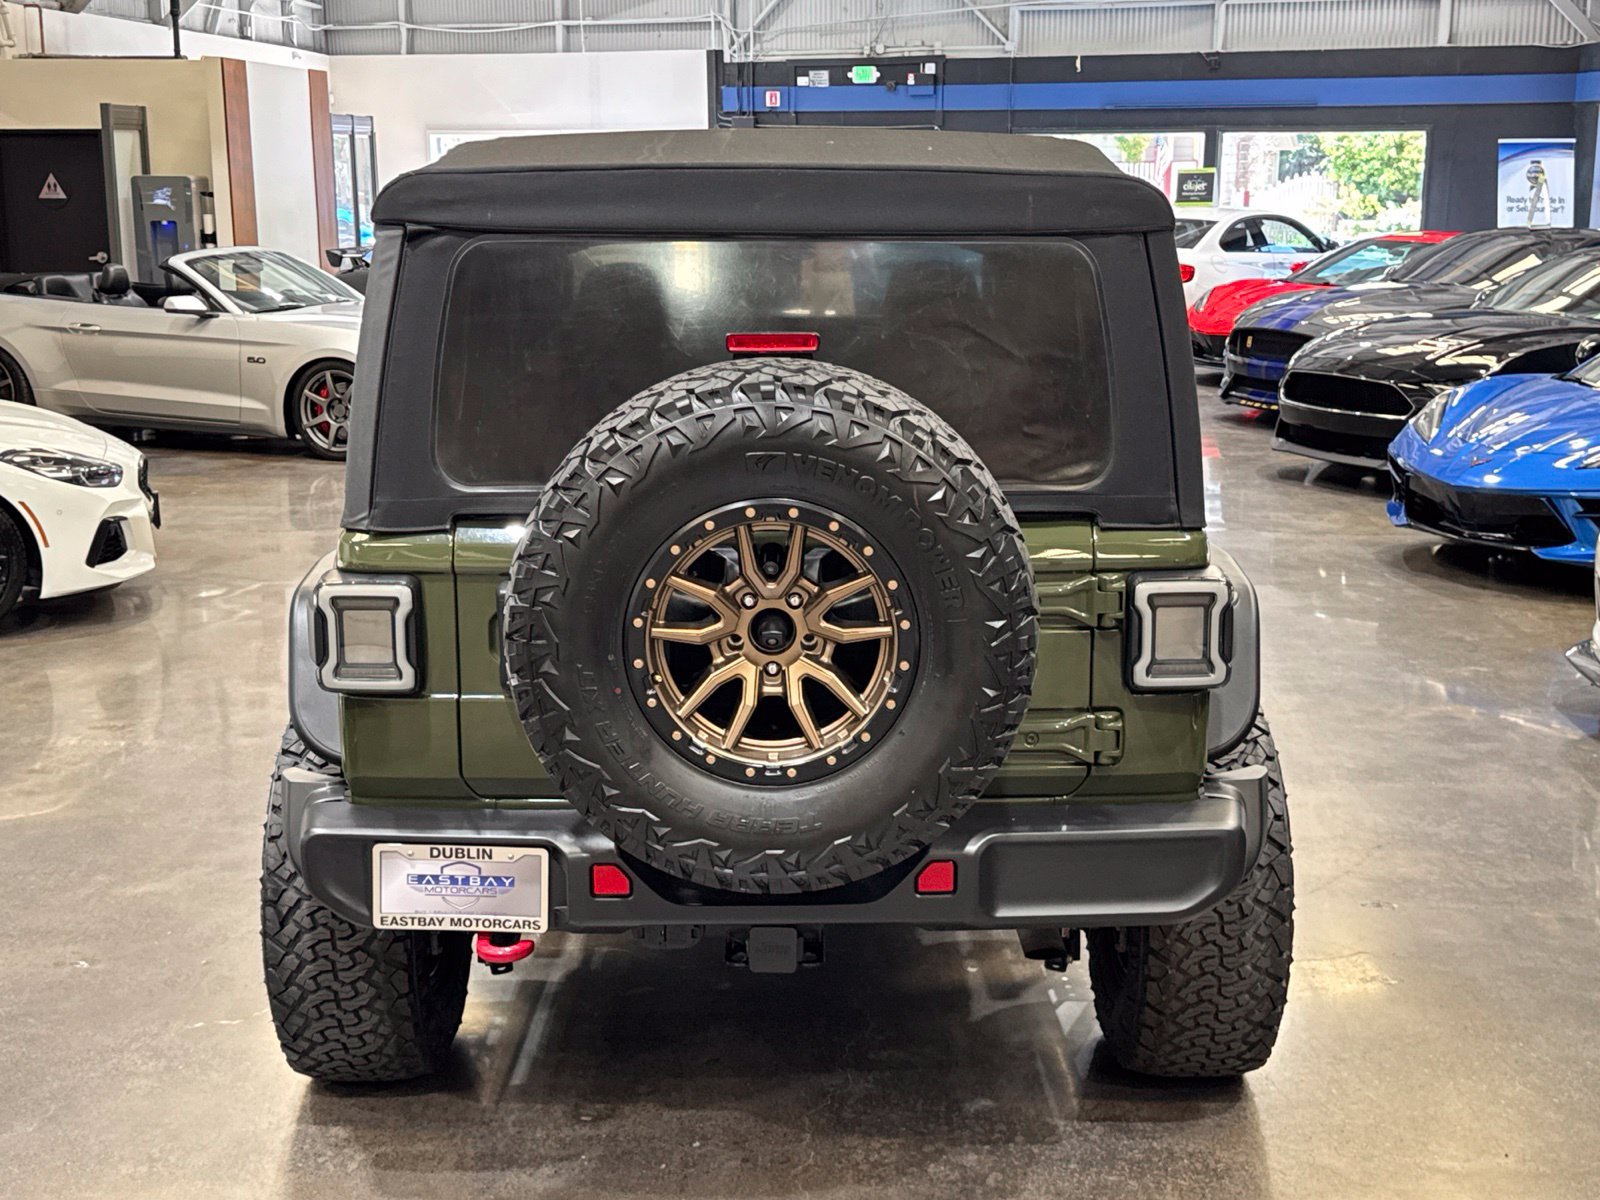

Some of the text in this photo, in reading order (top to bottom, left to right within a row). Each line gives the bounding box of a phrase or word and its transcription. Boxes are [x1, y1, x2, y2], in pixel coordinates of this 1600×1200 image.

[1506, 196, 1527, 205] Ready
[1557, 196, 1565, 204] In
[247, 356, 266, 364] 5.0
[792, 452, 966, 609] VENOM POWER
[595, 720, 704, 820] HUNTER
[706, 804, 823, 836] TERRA
[429, 847, 492, 860] DUBLIN
[407, 874, 515, 888] EASTBAY
[424, 886, 497, 895] MOTORCARS
[380, 916, 541, 930] EASTBAY MOTORCARS
